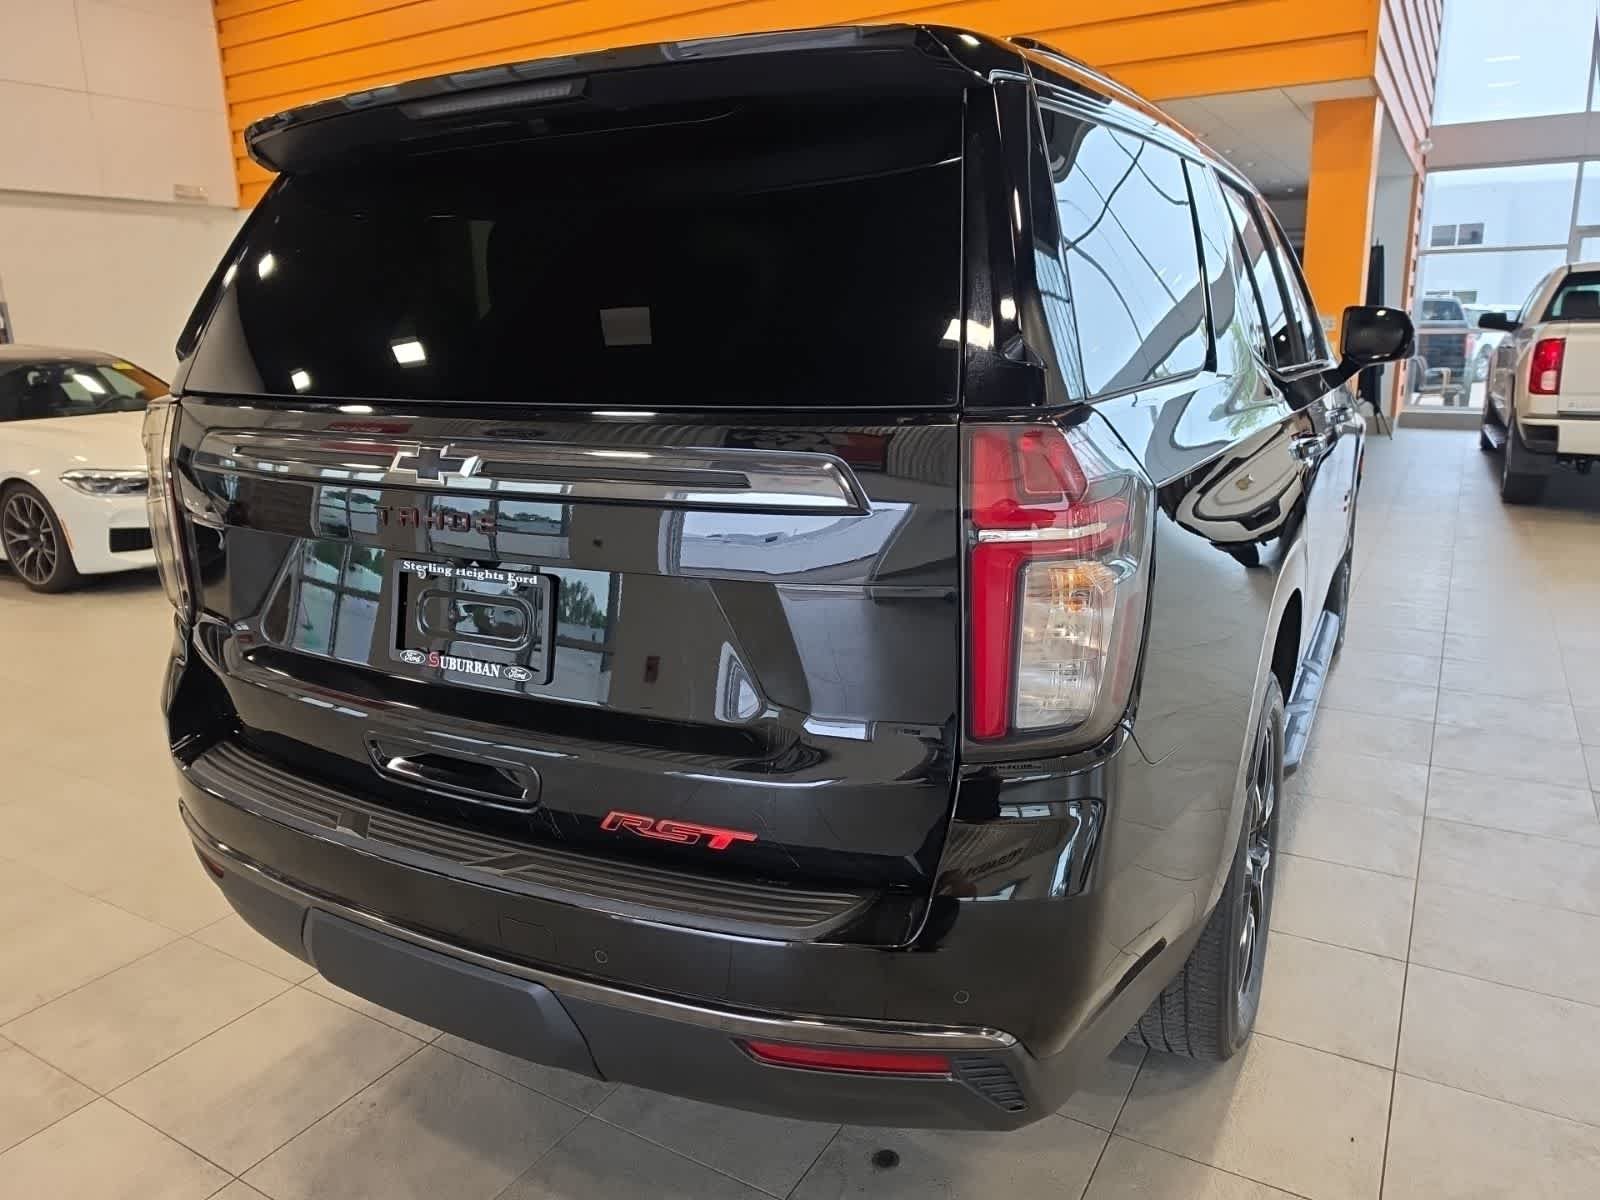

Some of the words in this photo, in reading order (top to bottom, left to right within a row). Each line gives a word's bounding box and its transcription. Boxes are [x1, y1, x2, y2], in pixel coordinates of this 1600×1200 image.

[374, 505, 498, 536] TAHOE
[403, 560, 452, 578] Sterling
[456, 567, 504, 581] Heights
[508, 572, 538, 585] Ford
[428, 651, 500, 678] SUBURBAN
[600, 810, 758, 850] RST
